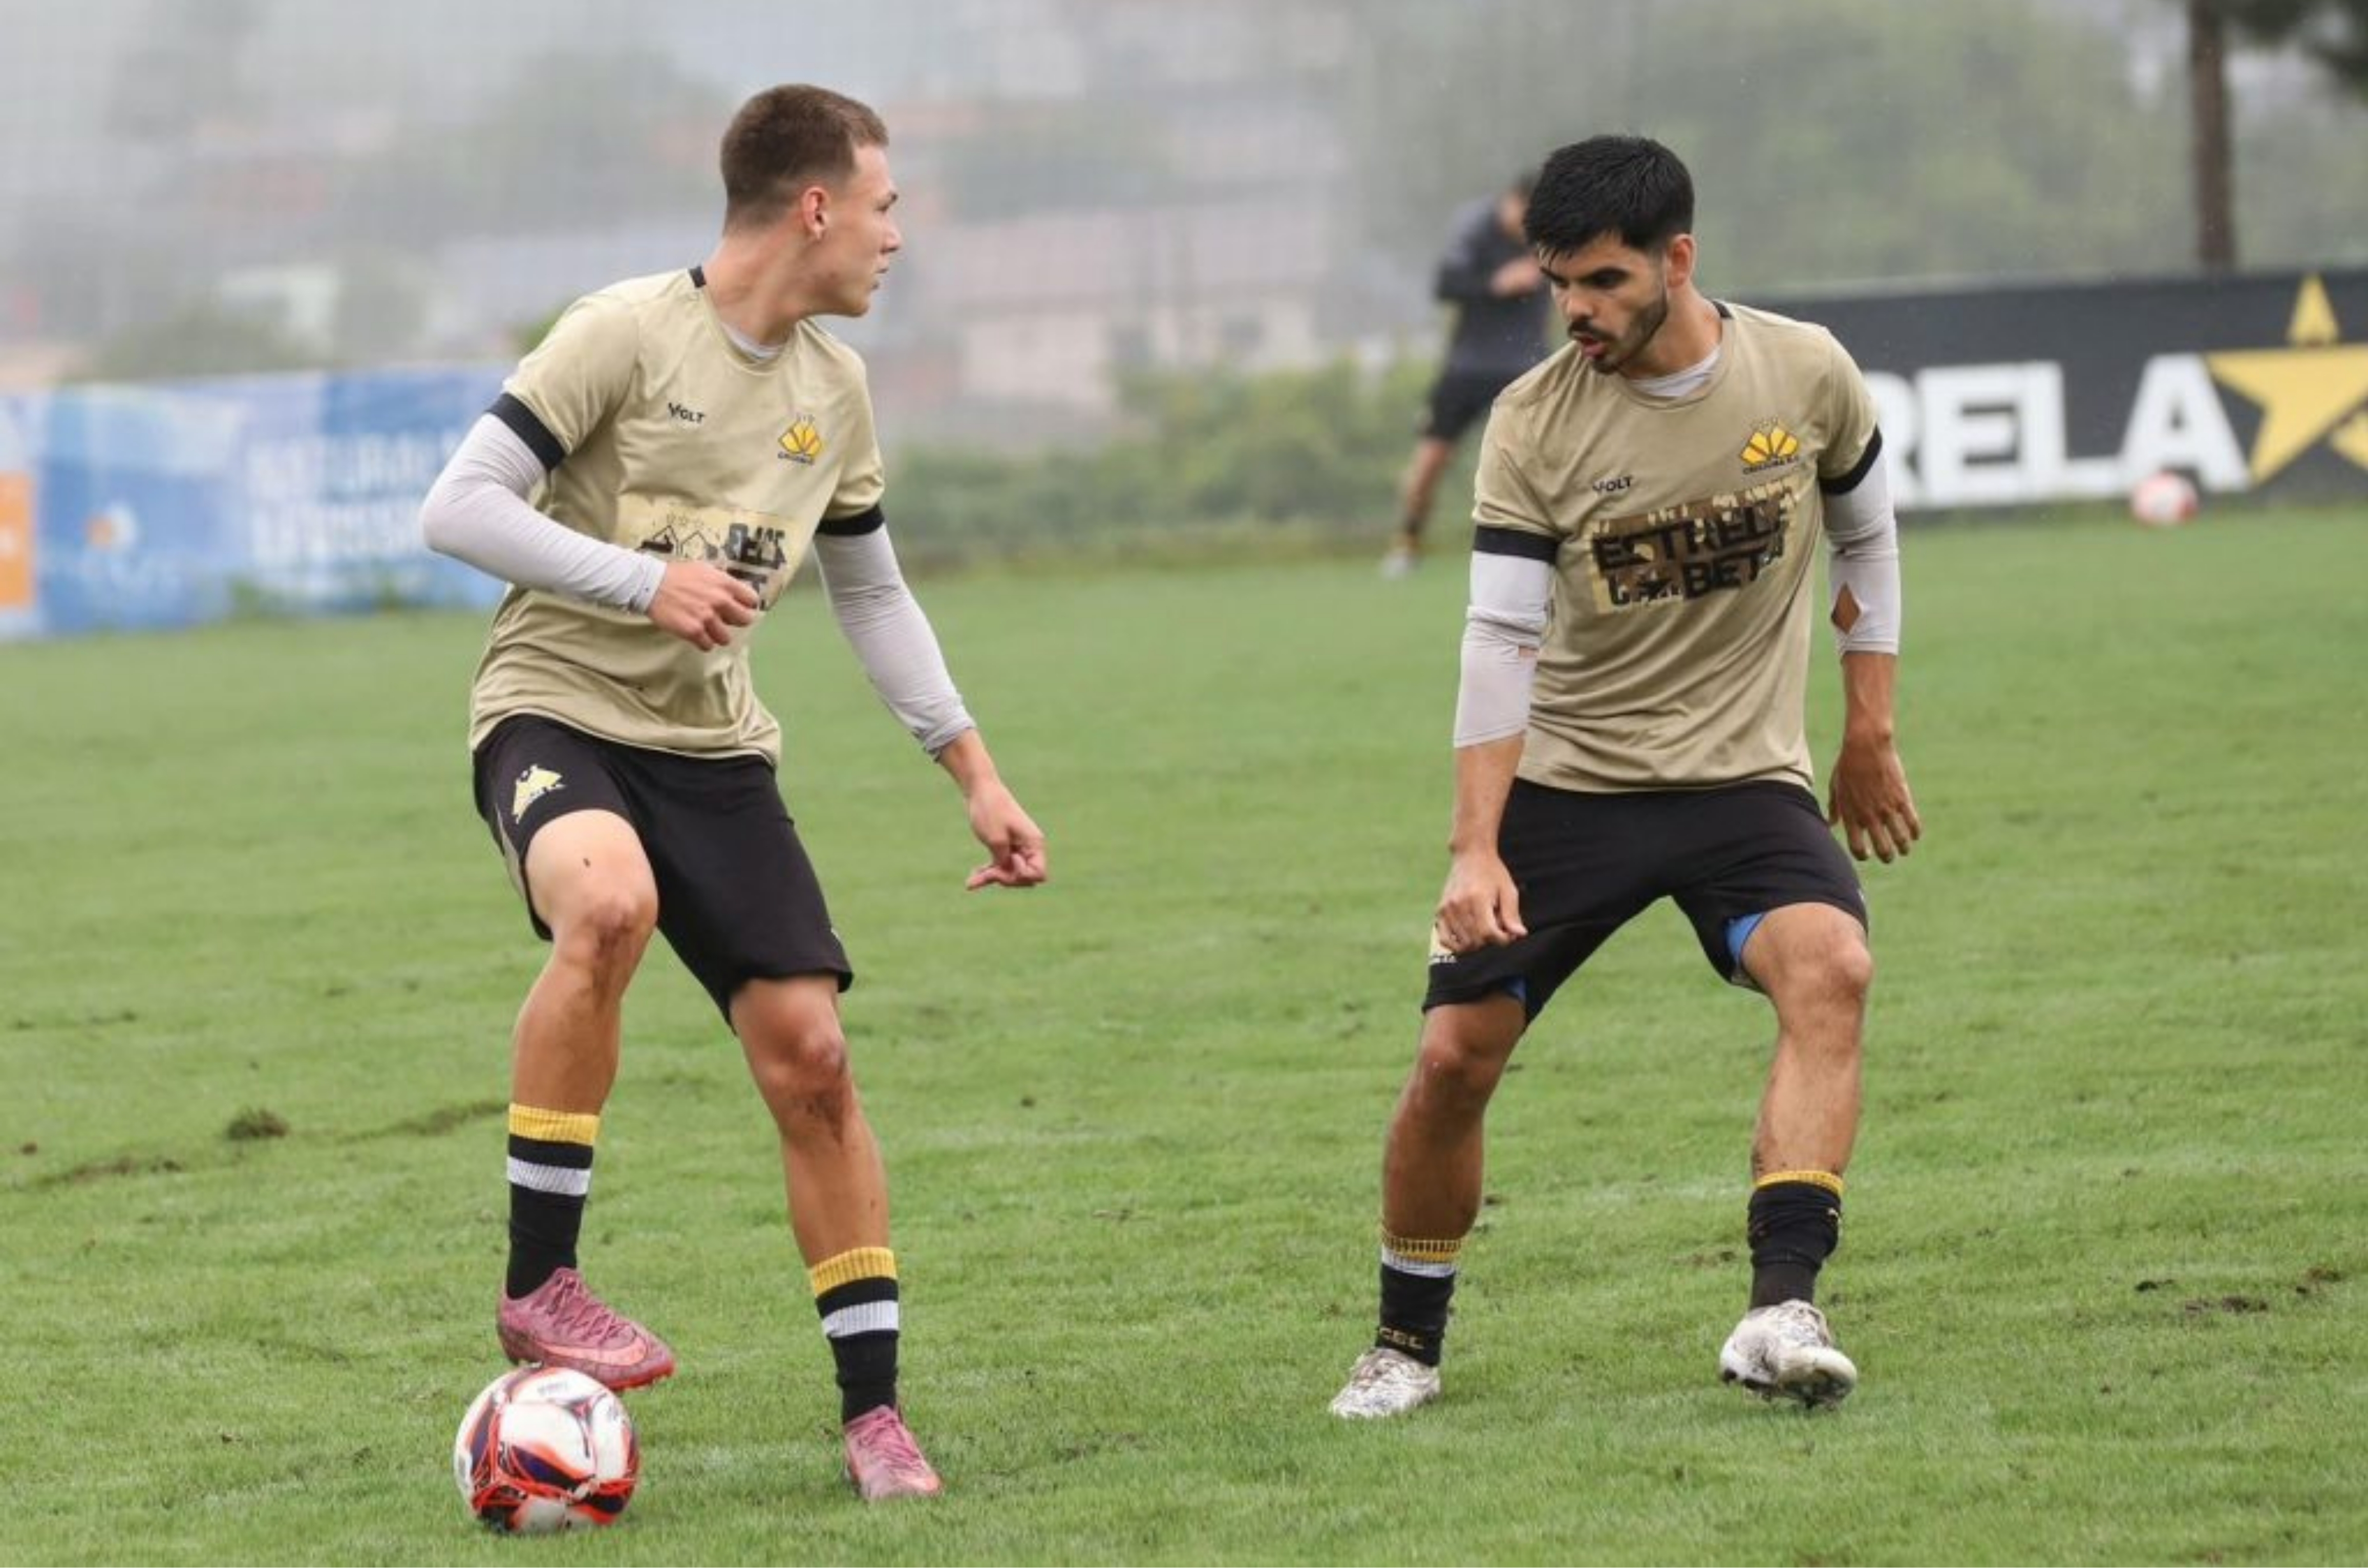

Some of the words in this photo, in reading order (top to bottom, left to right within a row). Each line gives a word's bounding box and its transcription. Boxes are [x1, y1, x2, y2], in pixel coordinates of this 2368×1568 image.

[668, 402, 706, 424] VOLT
[1864, 352, 2250, 509] RELA
[1591, 476, 1633, 494] VOLT
